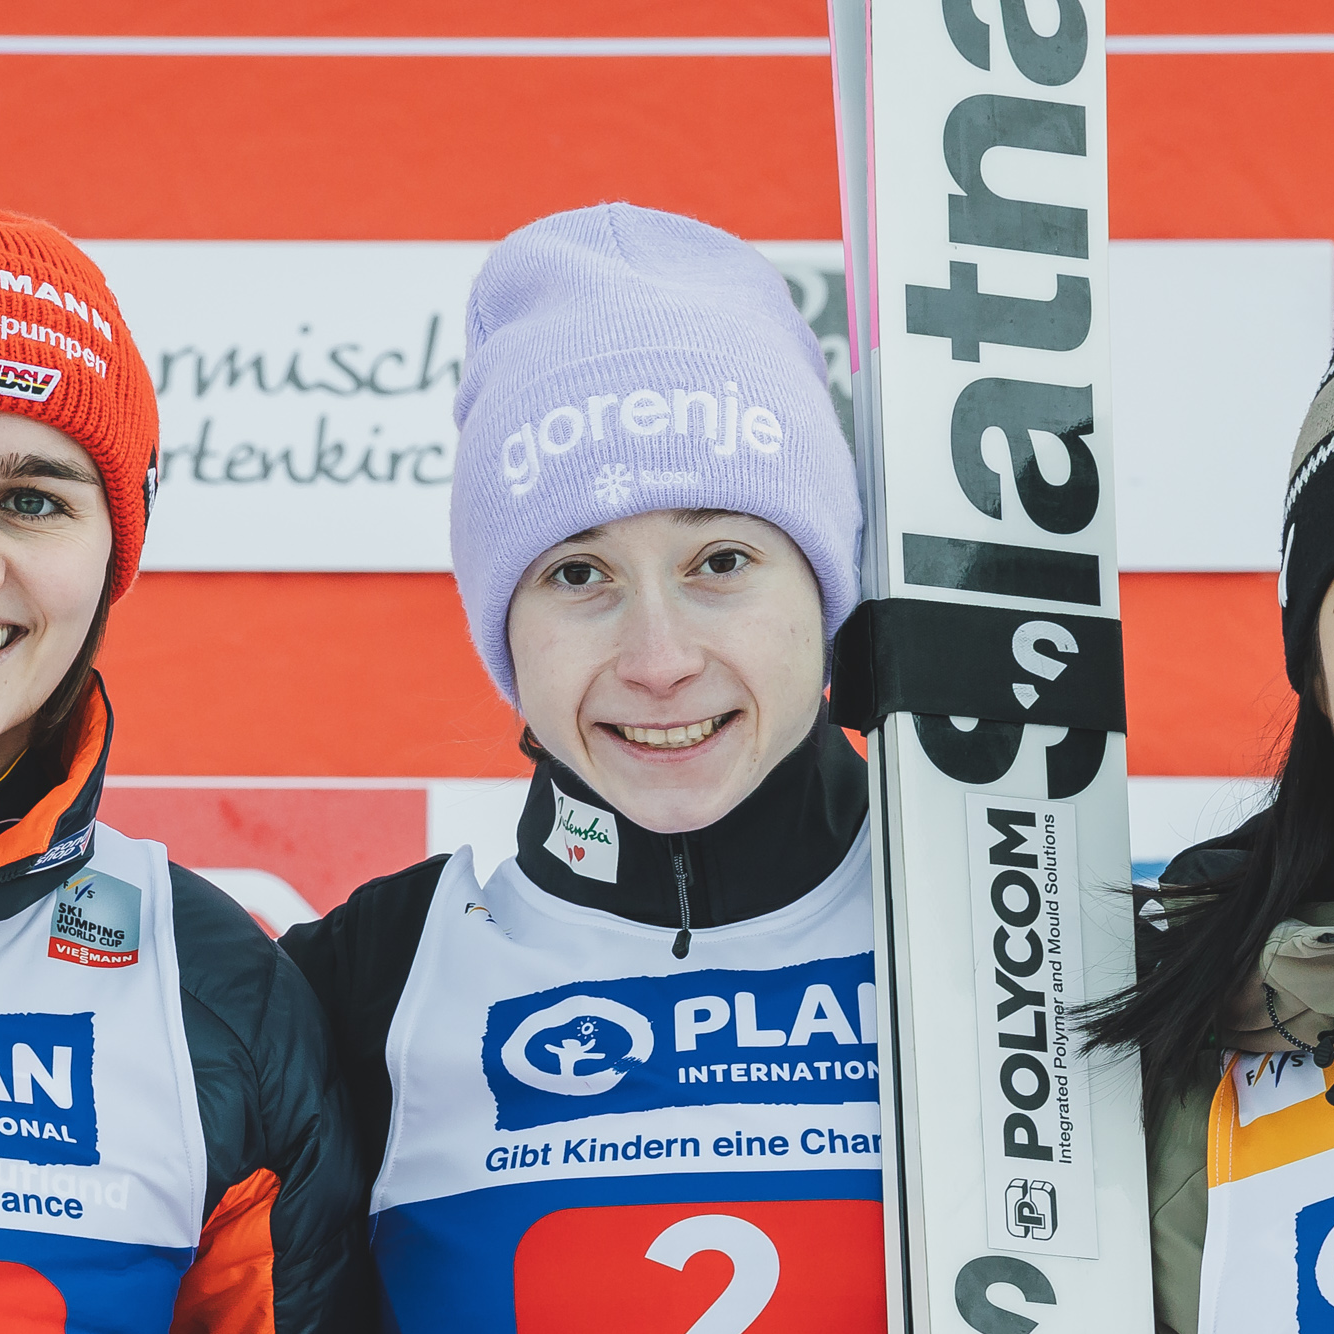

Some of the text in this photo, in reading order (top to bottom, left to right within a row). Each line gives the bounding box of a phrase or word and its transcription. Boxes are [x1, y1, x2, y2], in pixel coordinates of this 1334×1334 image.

[157, 313, 463, 397] rmisch
[2, 367, 53, 396] DSV
[160, 415, 454, 486] rtenkirc
[501, 381, 784, 497] gorenje
[58, 902, 83, 918] SKI
[56, 914, 126, 940] JUMPING
[56, 924, 123, 948] WORLD CUP
[55, 943, 134, 965] VIESSMANN
[985, 807, 1054, 1163] POLYCOM
[1041, 813, 1073, 1165] Integrated Polymer and Mould Solutions
[677, 1059, 880, 1084] INTERNATION
[1245, 1054, 1306, 1087] FIS
[484, 1143, 552, 1172] Gibt
[562, 1135, 701, 1164] Kindern
[712, 1130, 790, 1157] eine
